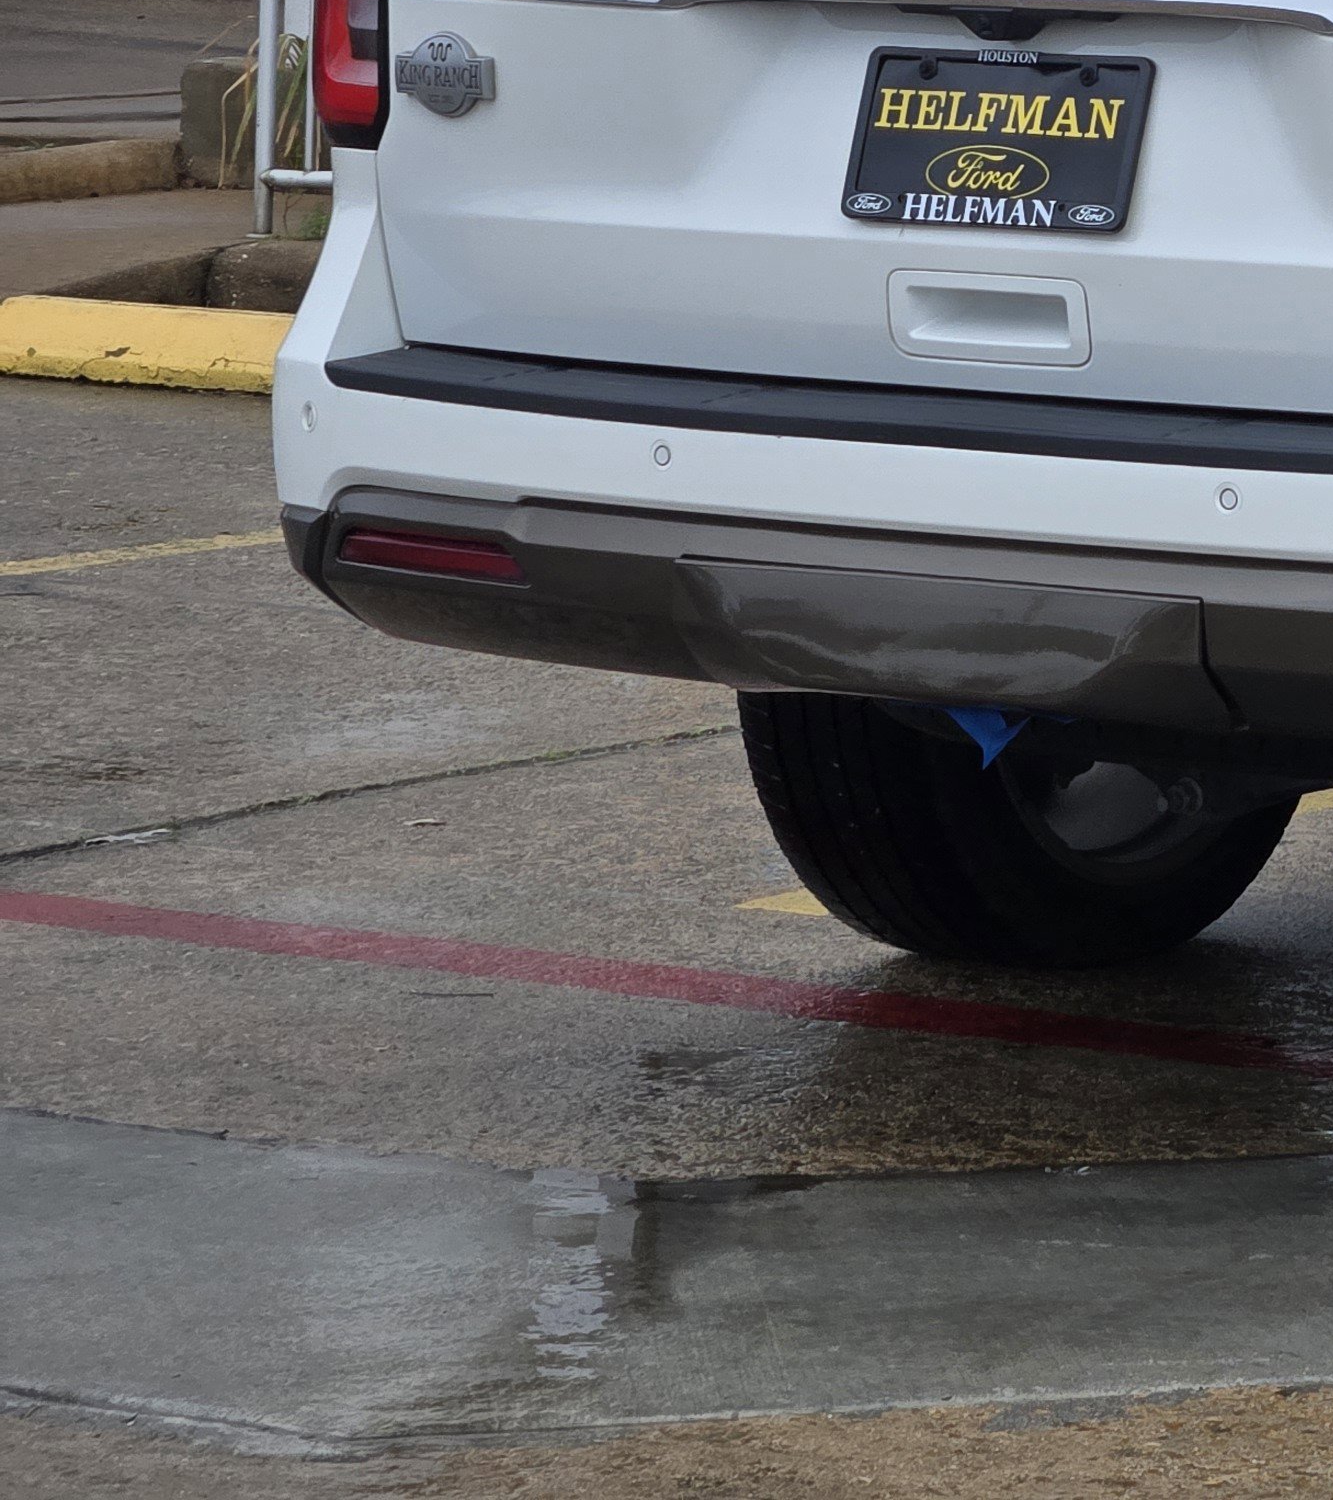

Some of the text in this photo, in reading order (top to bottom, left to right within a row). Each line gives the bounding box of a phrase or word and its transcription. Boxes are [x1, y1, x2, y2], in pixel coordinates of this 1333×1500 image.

[977, 49, 1038, 64] HOUSTON
[398, 60, 480, 90] KING RANCH
[874, 87, 1125, 139] HELFMAN
[946, 150, 1025, 192] Ford
[853, 194, 882, 211] Ford
[901, 192, 1056, 227] HELFMAN
[1075, 206, 1106, 223] Ford
